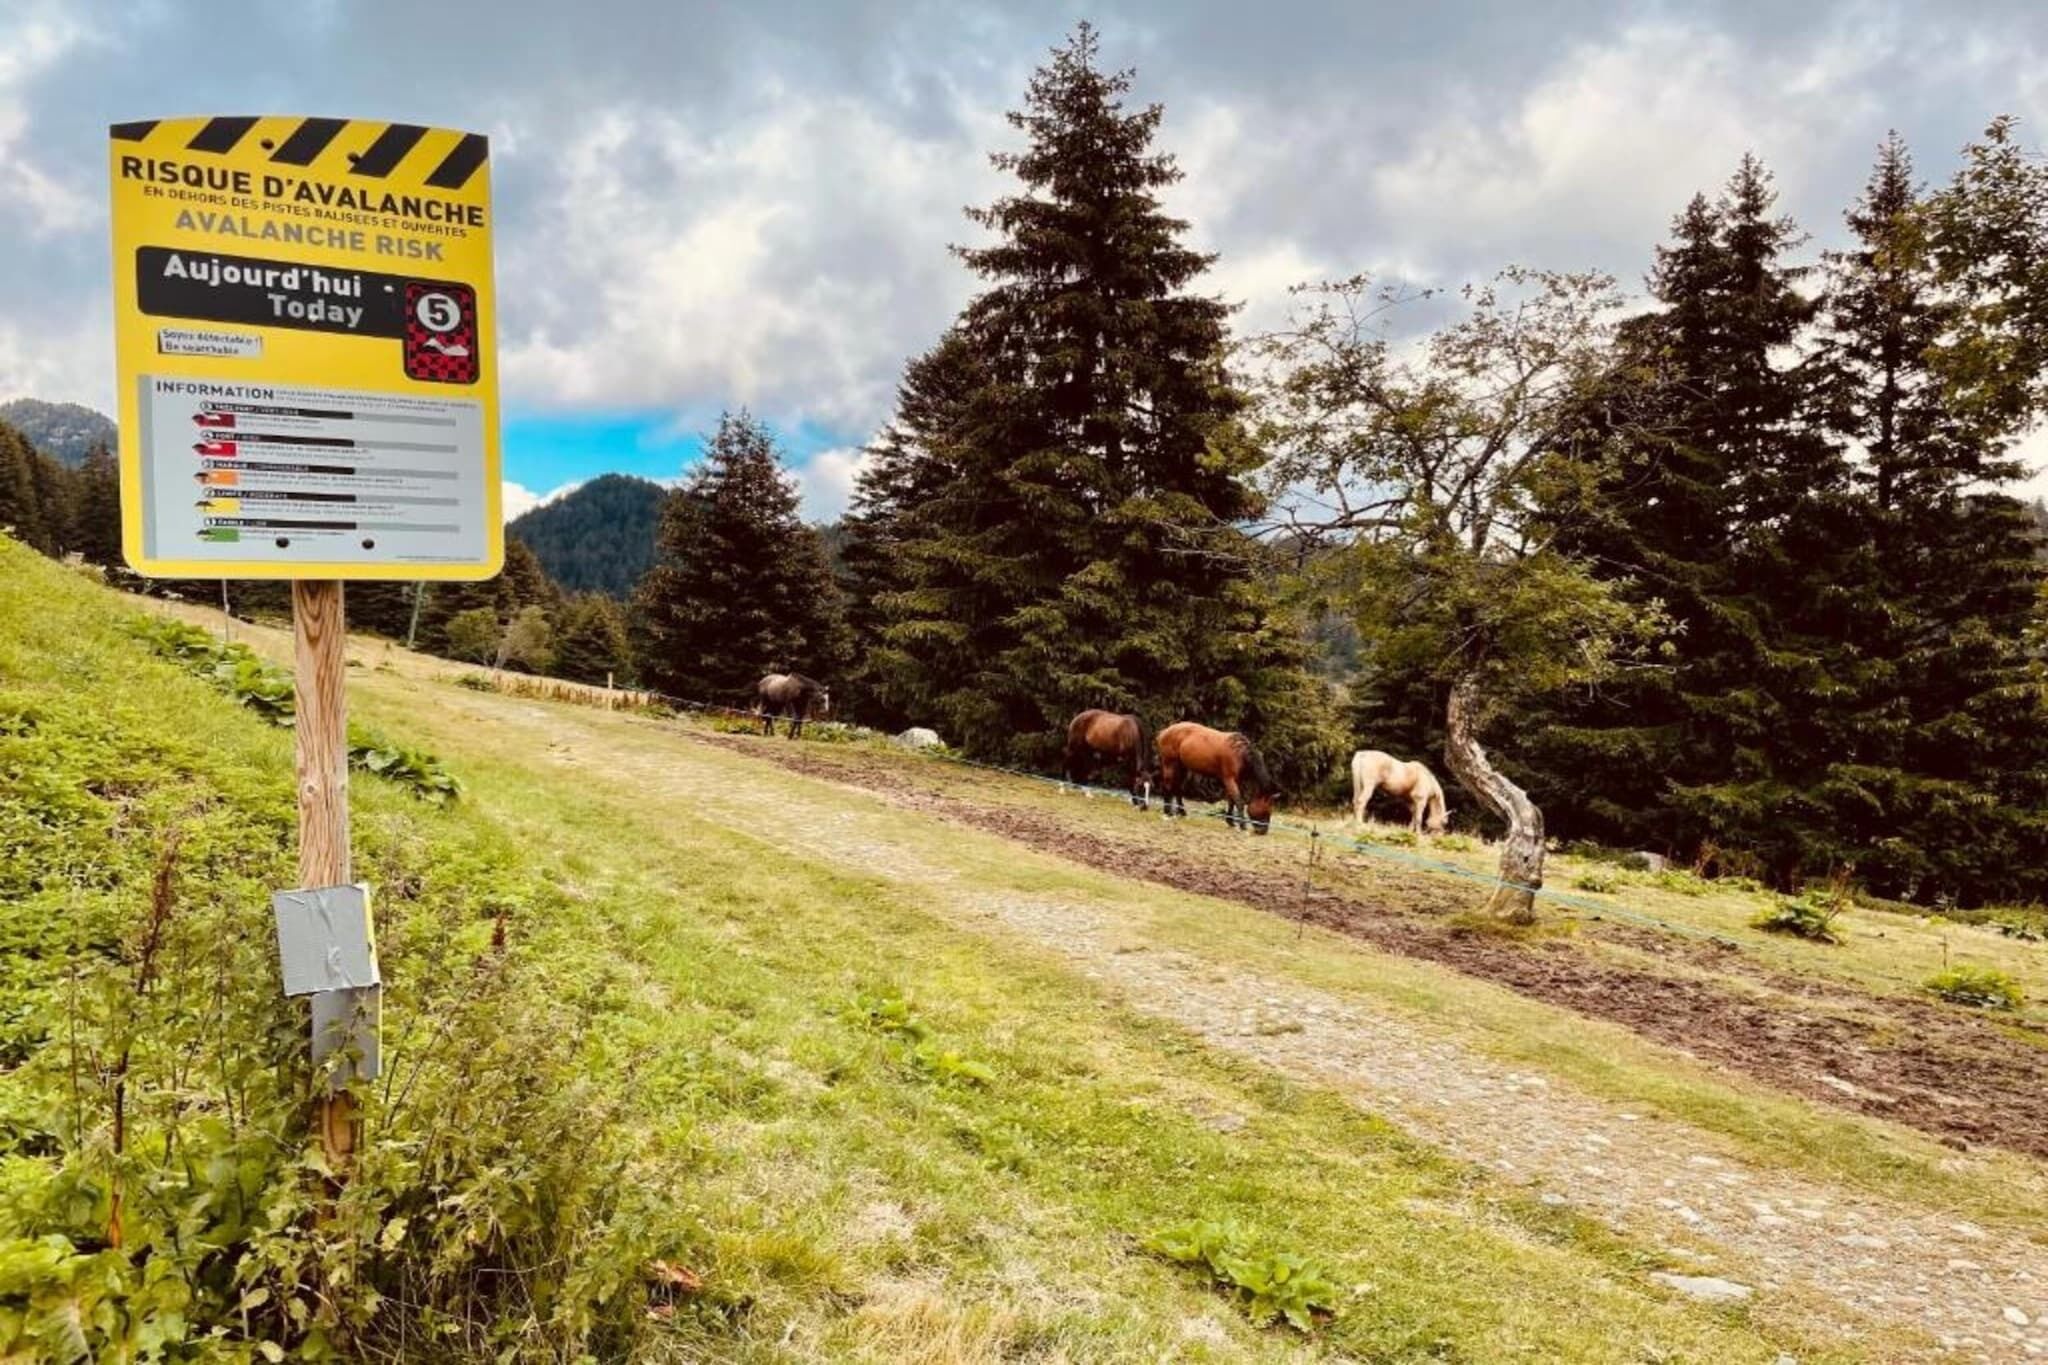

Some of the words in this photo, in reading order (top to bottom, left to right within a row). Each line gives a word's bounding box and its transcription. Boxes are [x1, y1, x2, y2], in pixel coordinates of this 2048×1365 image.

[122, 155, 251, 194] RISQUE
[263, 175, 484, 227] D'AVALANCHE
[143, 186, 163, 197] EN
[168, 188, 227, 205] DEHORS
[231, 196, 258, 210] DES
[263, 201, 311, 217] PISTES
[383, 218, 398, 229] ET
[401, 221, 467, 239] OUVERTES
[175, 208, 365, 251] AVALANCHE
[376, 235, 444, 261] RISK
[163, 254, 361, 297] Aujourd'hui
[267, 293, 364, 328] Today
[426, 298, 450, 326] 5
[156, 380, 274, 400] INFORMATION
